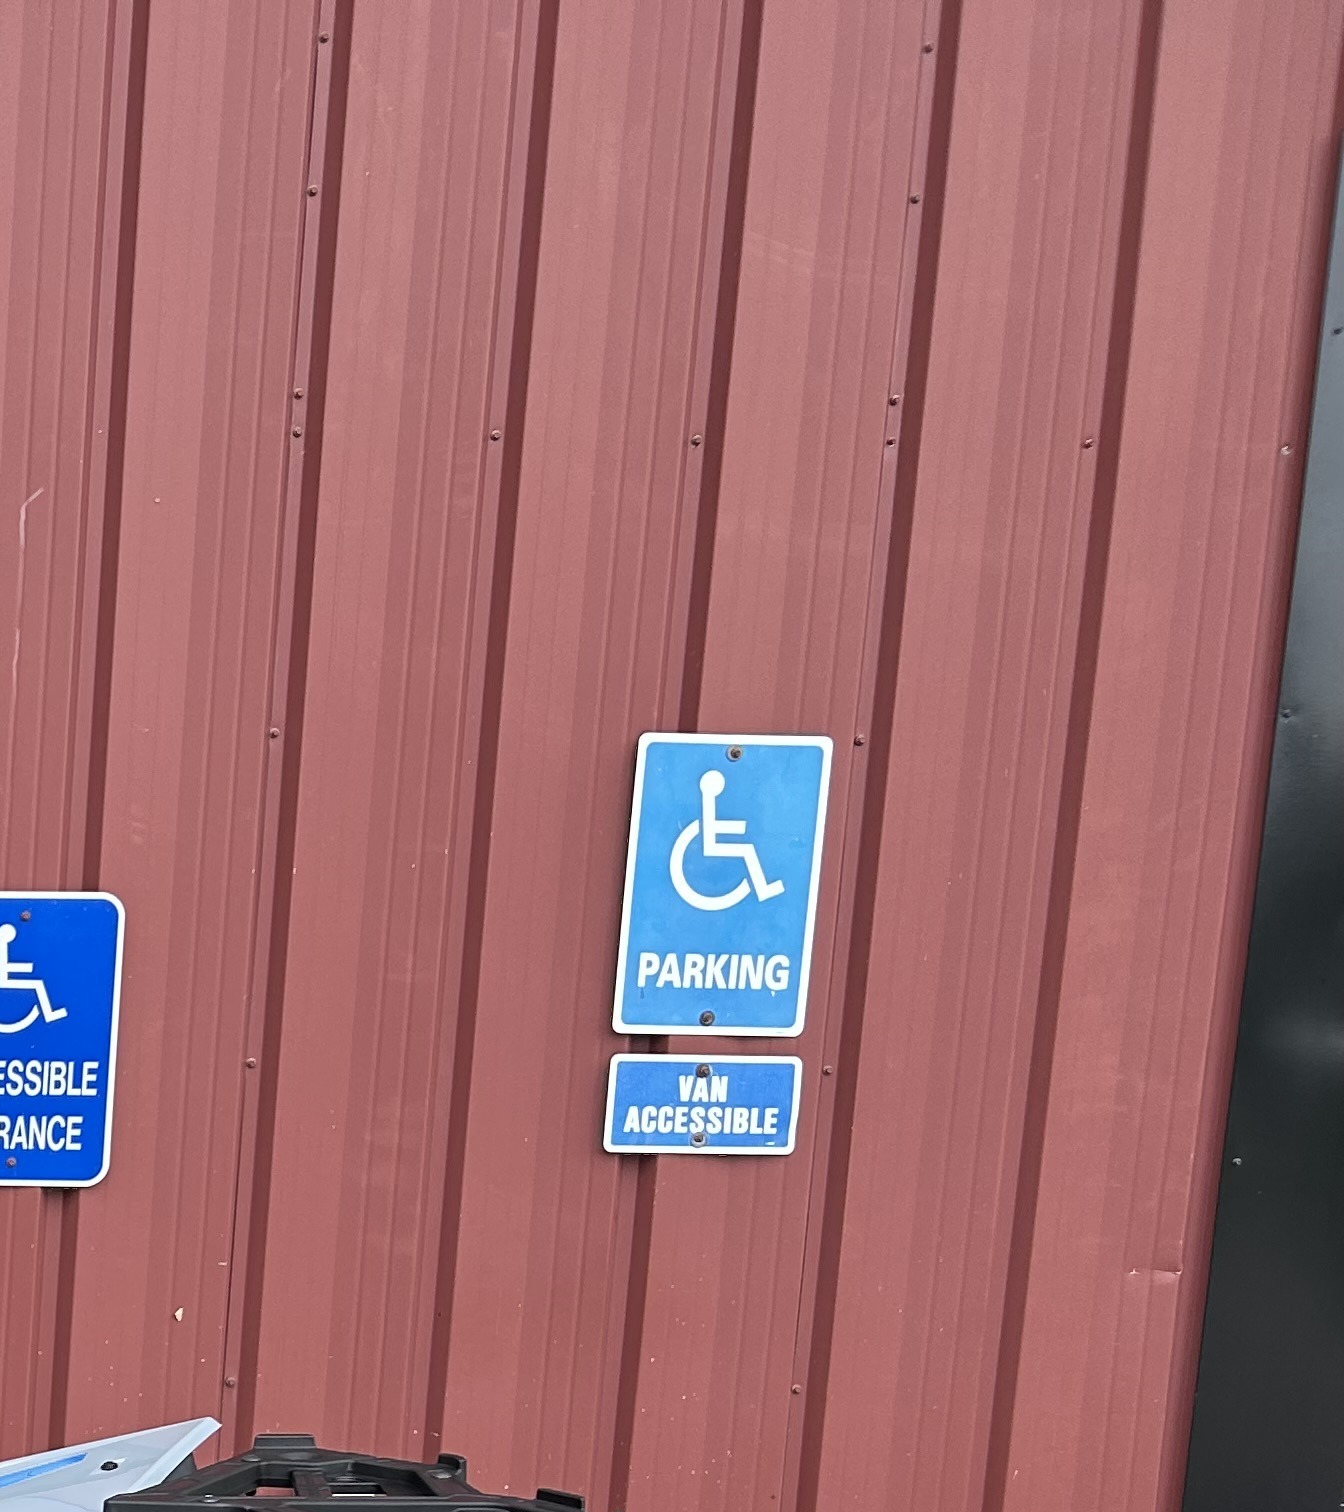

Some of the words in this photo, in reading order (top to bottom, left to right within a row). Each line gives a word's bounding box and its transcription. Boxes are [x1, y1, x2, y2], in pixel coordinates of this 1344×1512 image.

[637, 951, 791, 991] PARKING
[678, 1075, 729, 1103] VAN
[622, 1105, 780, 1135] ACCESSIBLE
